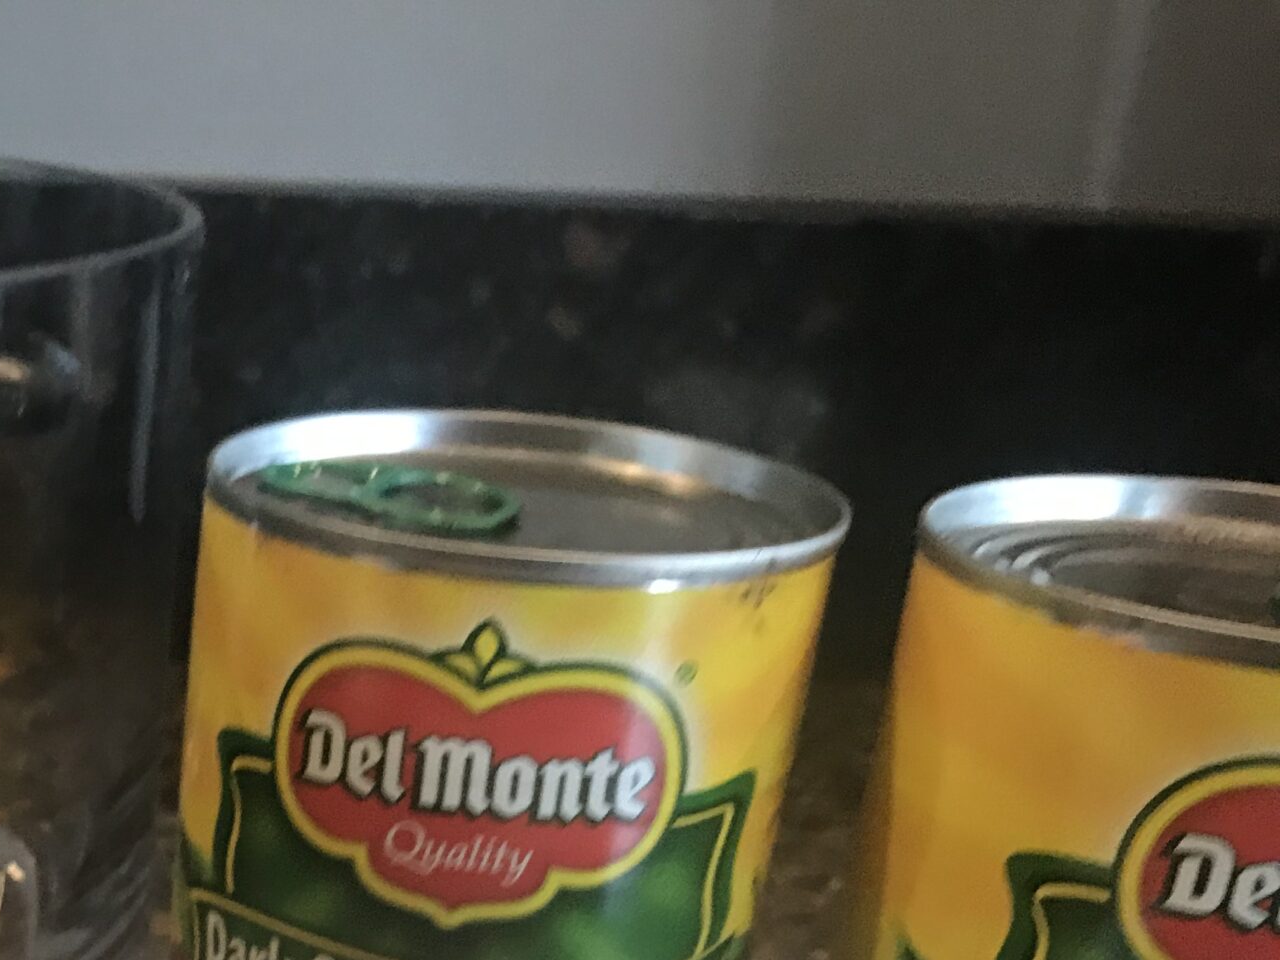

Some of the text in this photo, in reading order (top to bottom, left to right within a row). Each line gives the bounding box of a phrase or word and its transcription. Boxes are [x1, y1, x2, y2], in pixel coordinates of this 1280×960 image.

[299, 707, 658, 825] Del Monte
[383, 819, 534, 886] Quality
[1156, 832, 1280, 931] De
